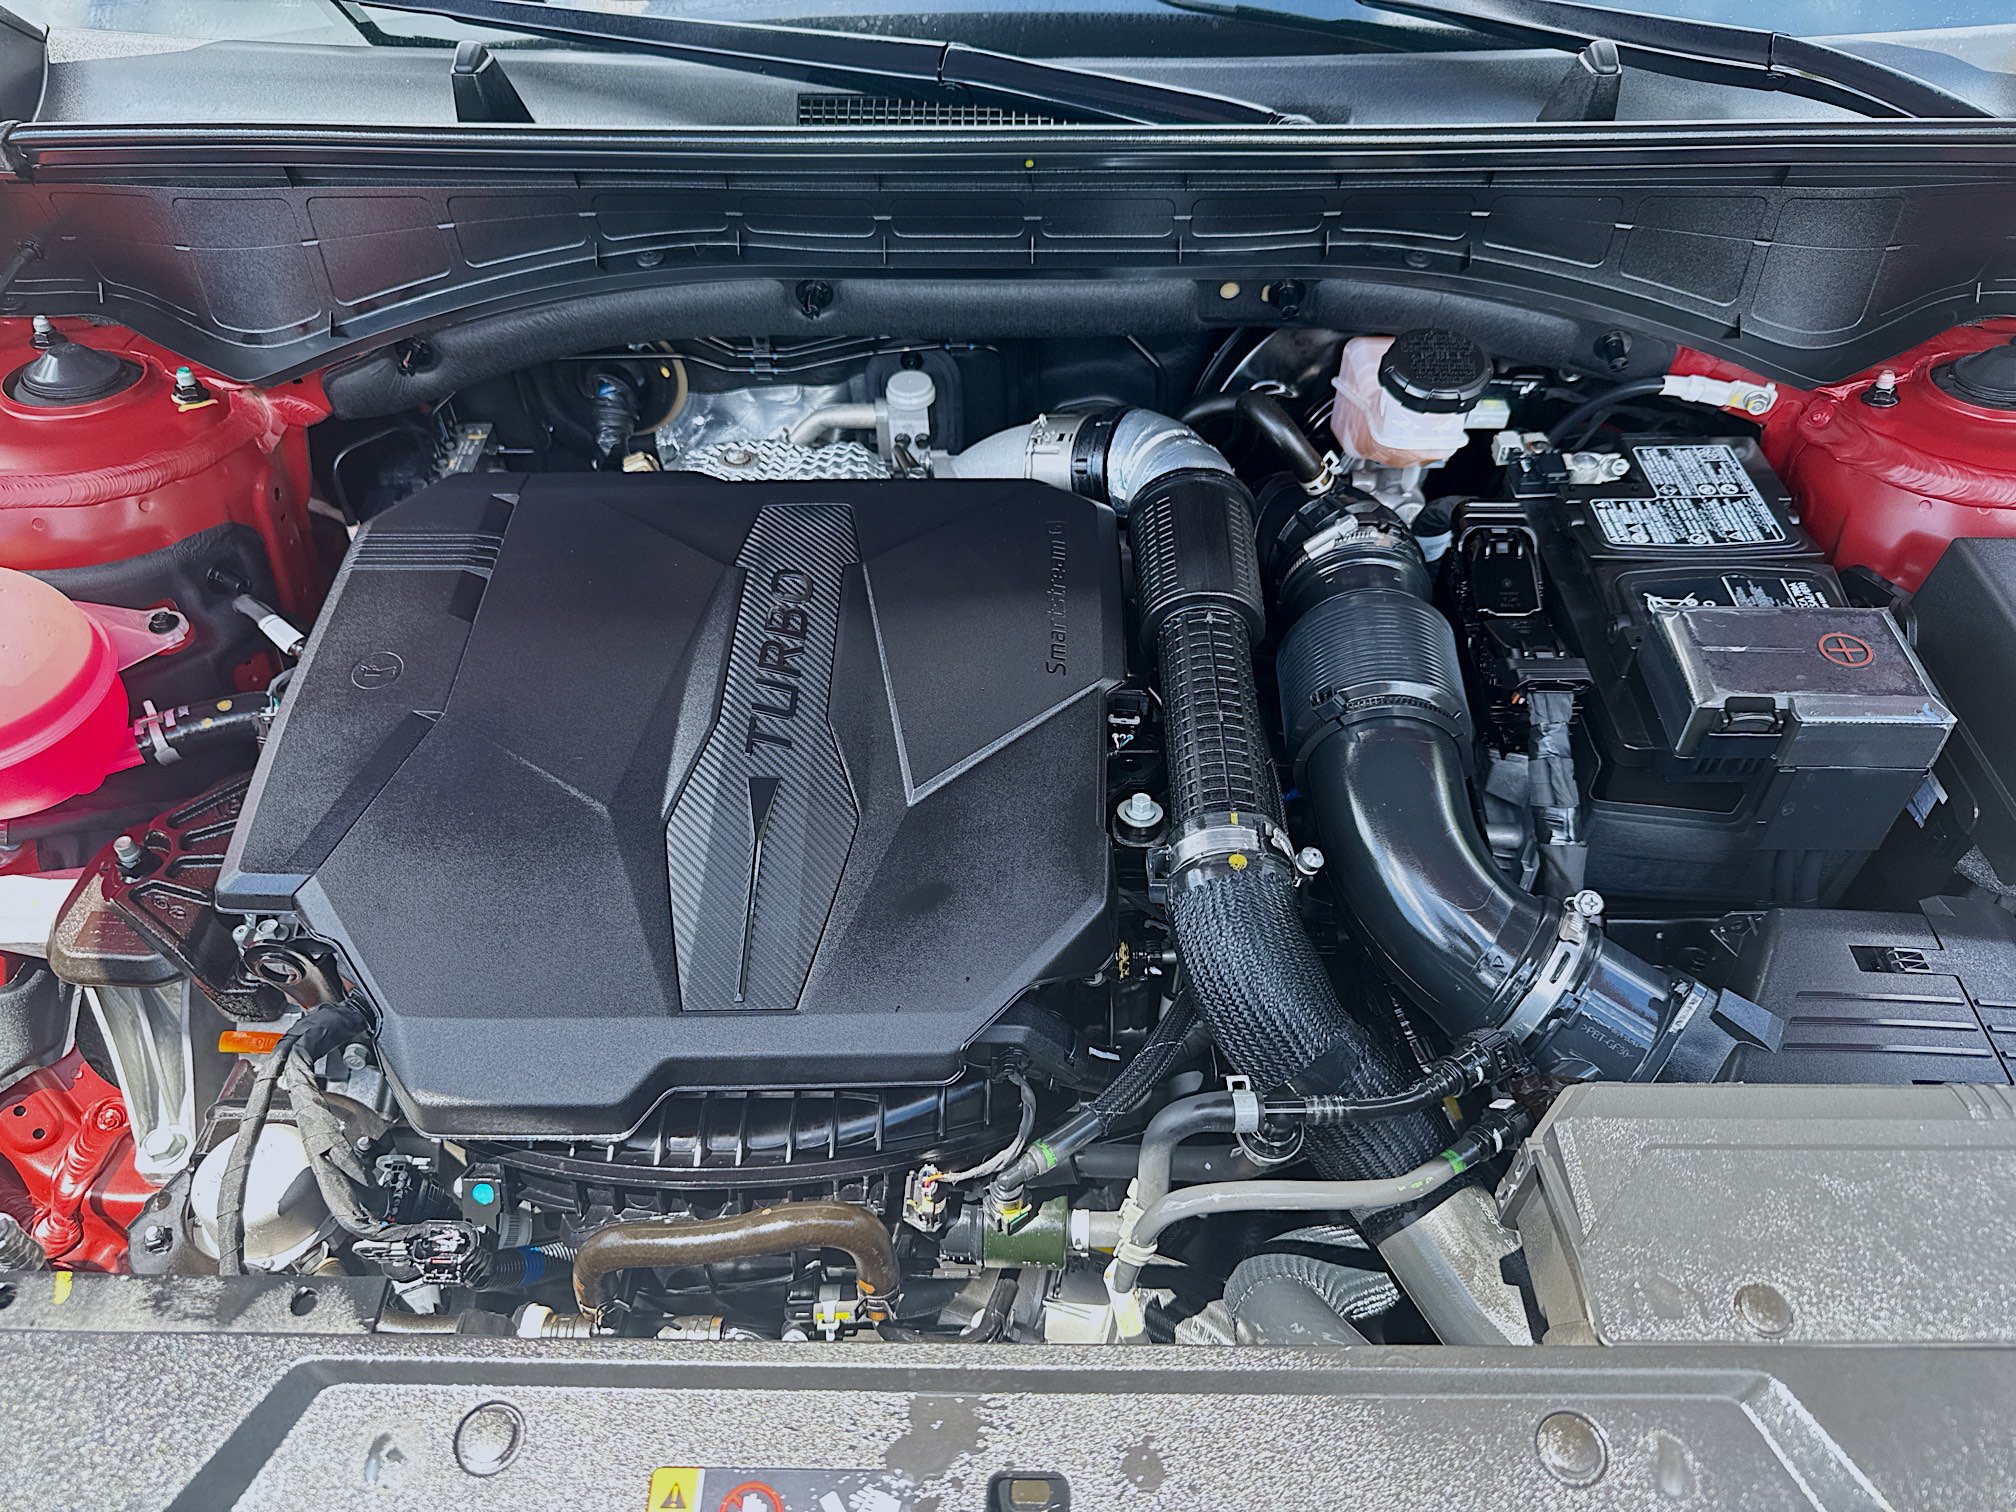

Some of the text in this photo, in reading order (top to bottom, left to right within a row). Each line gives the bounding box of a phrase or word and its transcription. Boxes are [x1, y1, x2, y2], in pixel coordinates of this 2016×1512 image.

[745, 567, 814, 756] TURBO
[1045, 540, 1067, 676] Smartstream
[1475, 1196, 1506, 1234] 240509-S
